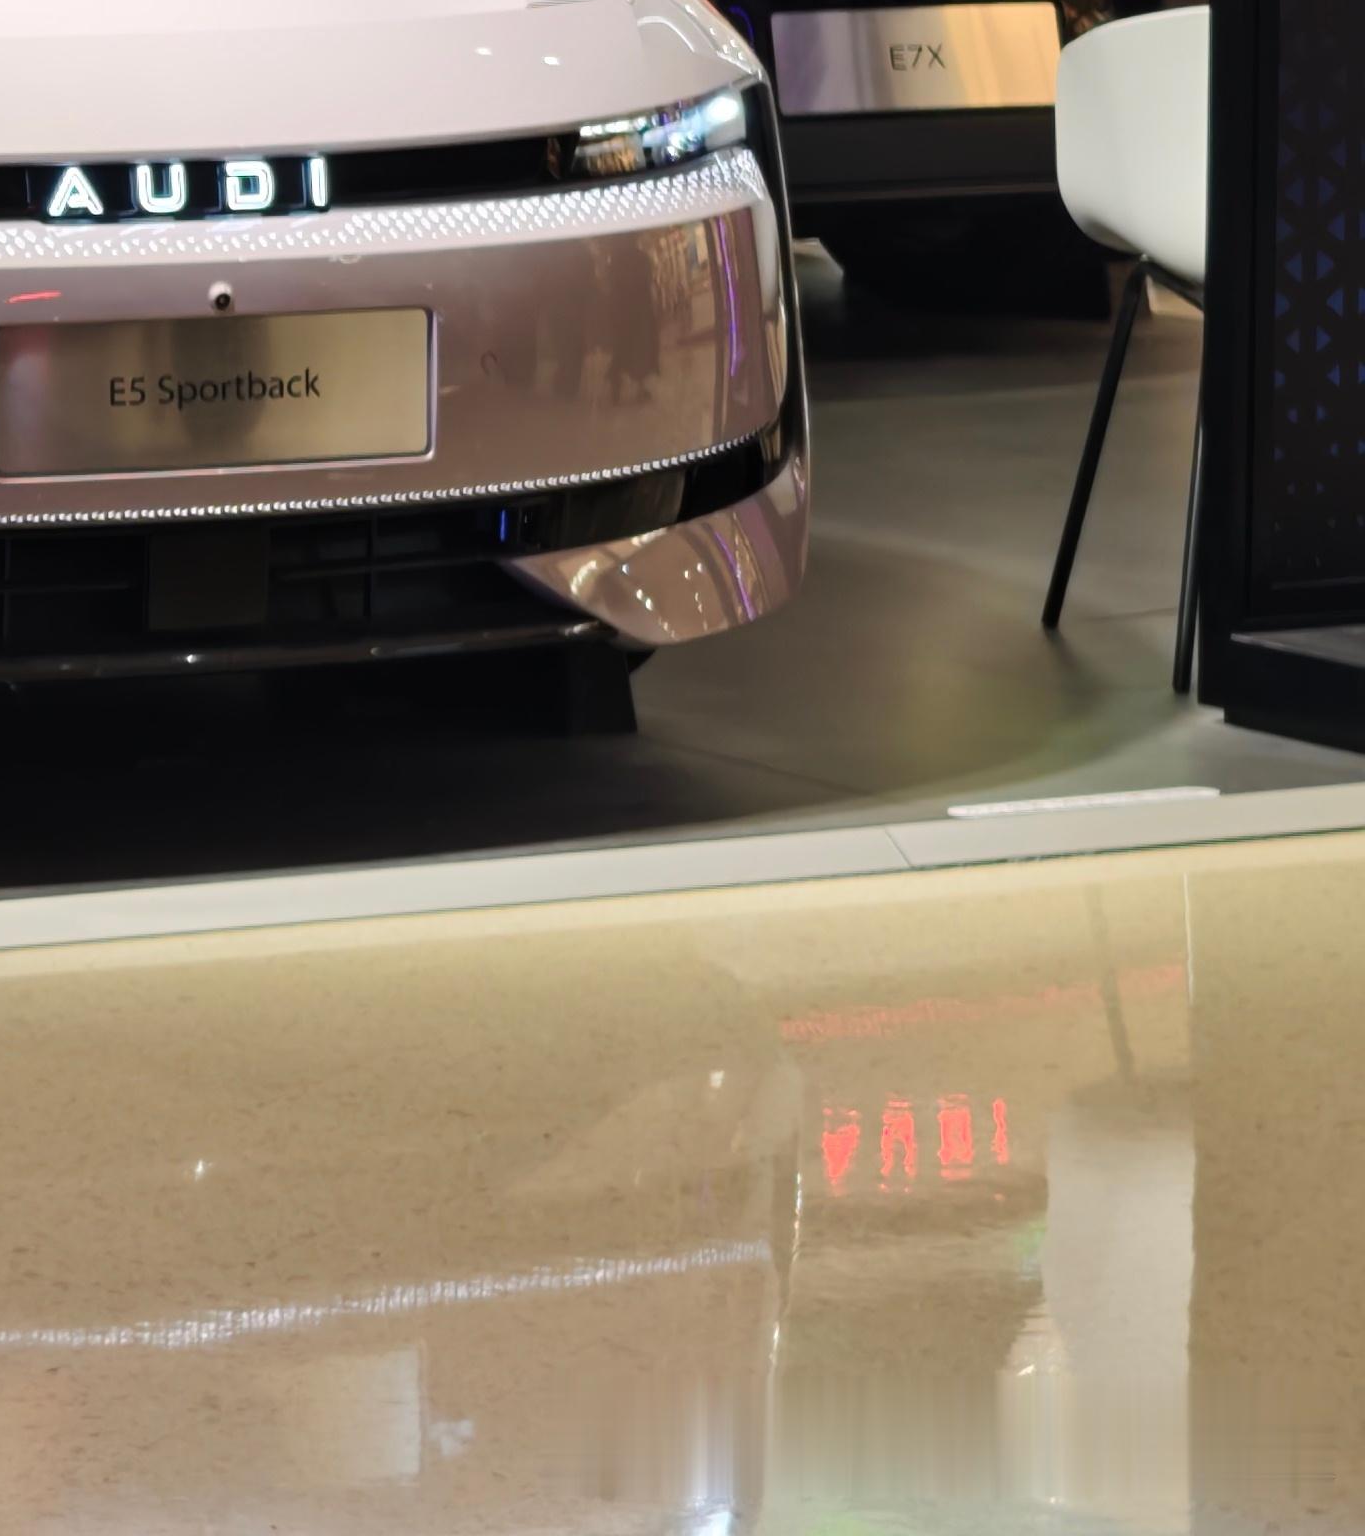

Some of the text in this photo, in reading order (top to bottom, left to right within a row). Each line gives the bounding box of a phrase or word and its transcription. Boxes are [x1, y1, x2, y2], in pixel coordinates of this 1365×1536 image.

[889, 43, 946, 71] E7X
[47, 158, 327, 217] AUDI
[109, 366, 320, 411] E5 Sportback
